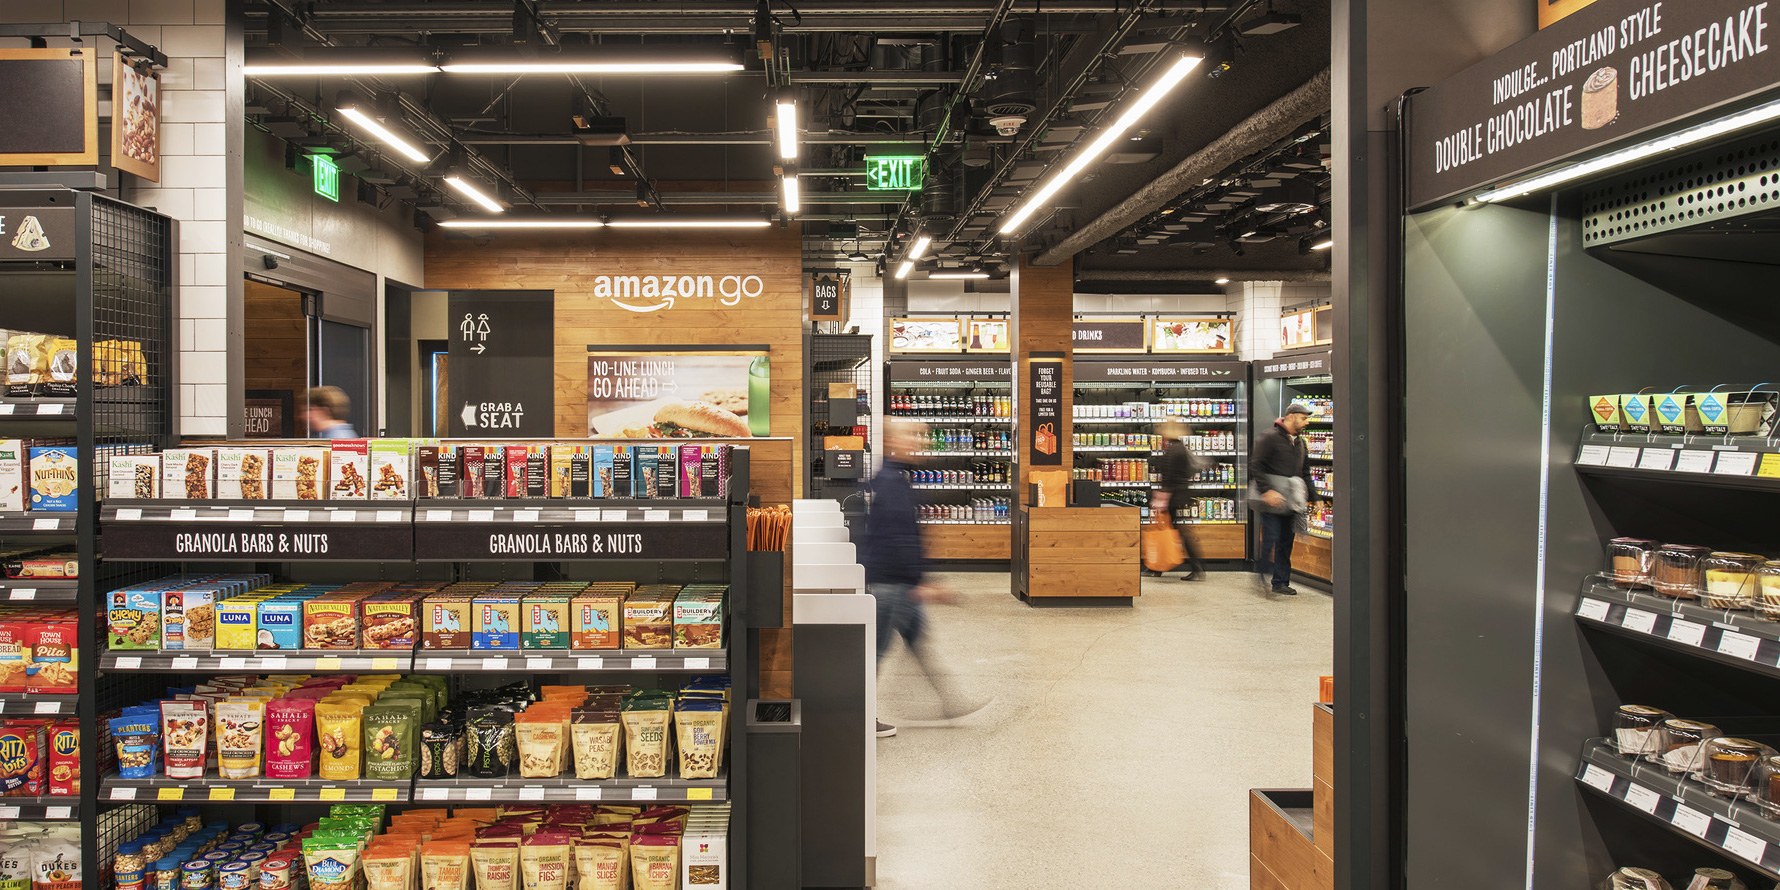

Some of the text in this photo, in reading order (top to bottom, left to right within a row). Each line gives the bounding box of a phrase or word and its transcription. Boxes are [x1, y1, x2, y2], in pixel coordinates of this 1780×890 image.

[1493, 2, 1662, 105] INDULGE... PORTLAND STYLE
[1436, 2, 1769, 174] DOUBLE CHOCOLATE CHEESECAKE
[320, 160, 337, 198] EXIT
[878, 160, 913, 188] EXIT
[594, 275, 764, 306] amazon go
[816, 285, 836, 298] BAGS
[1078, 330, 1102, 340] DRINKS
[594, 361, 675, 377] NO-LINE LUNCH
[594, 378, 658, 398] GO AHEAD
[250, 408, 272, 417] LUNCH
[480, 402, 523, 412] GRAB A
[245, 418, 269, 432] HEAD
[480, 413, 524, 428] SEAT
[176, 533, 328, 553] GRANOLA BARS & NUTS
[490, 533, 642, 553] GRANOLA BARS & NUTS
[310, 604, 349, 612] NATURE VALLEY
[367, 604, 409, 613] NATURE VALLEY
[37, 646, 67, 656] Pita
[118, 724, 151, 732] PLANTERS
[56, 735, 76, 752] RITZ
[589, 736, 612, 744] WASABI
[641, 732, 663, 742] SEEDS
[3, 758, 26, 773] bits
[597, 862, 617, 870] MANGO
[487, 872, 510, 880] RAISINS
[539, 871, 556, 881] FIGS
[597, 871, 617, 879] SLICES
